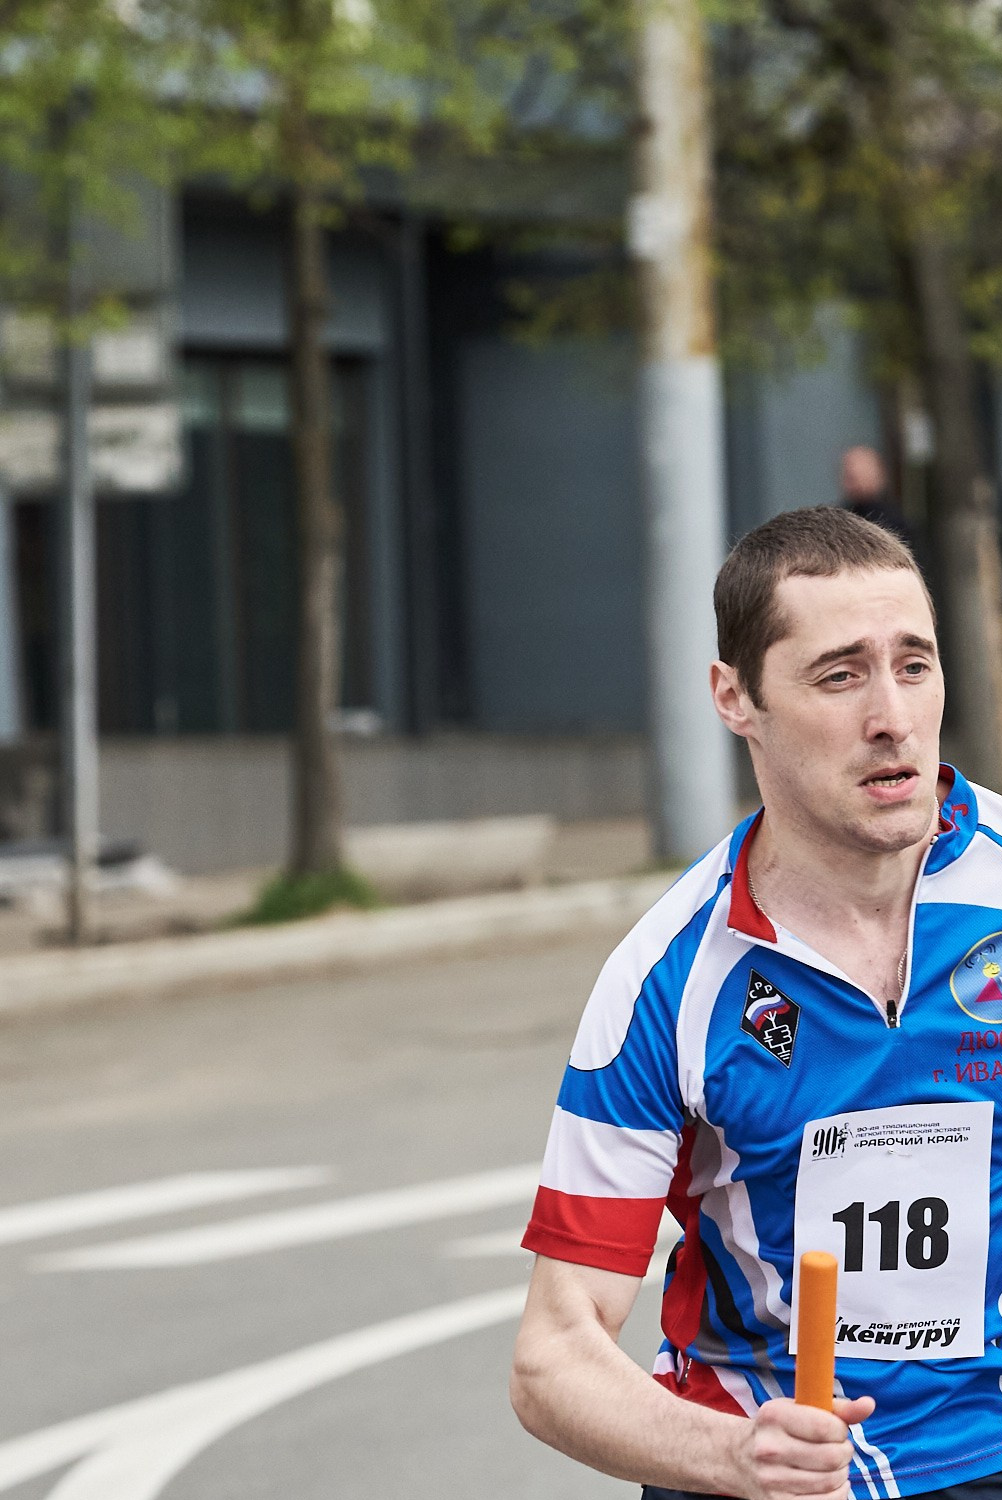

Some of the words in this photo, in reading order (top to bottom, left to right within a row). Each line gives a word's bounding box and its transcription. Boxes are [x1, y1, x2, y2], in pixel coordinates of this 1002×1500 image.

[812, 1125, 838, 1158] 90
[853, 1136, 923, 1149] «РАБОЧИЙ
[927, 1133, 969, 1145] КРАЙ»
[832, 1196, 950, 1273] 118
[837, 1323, 960, 1350] Кенгуру
[896, 1320, 937, 1330] РЕМОНТ
[940, 1317, 961, 1326] САД
